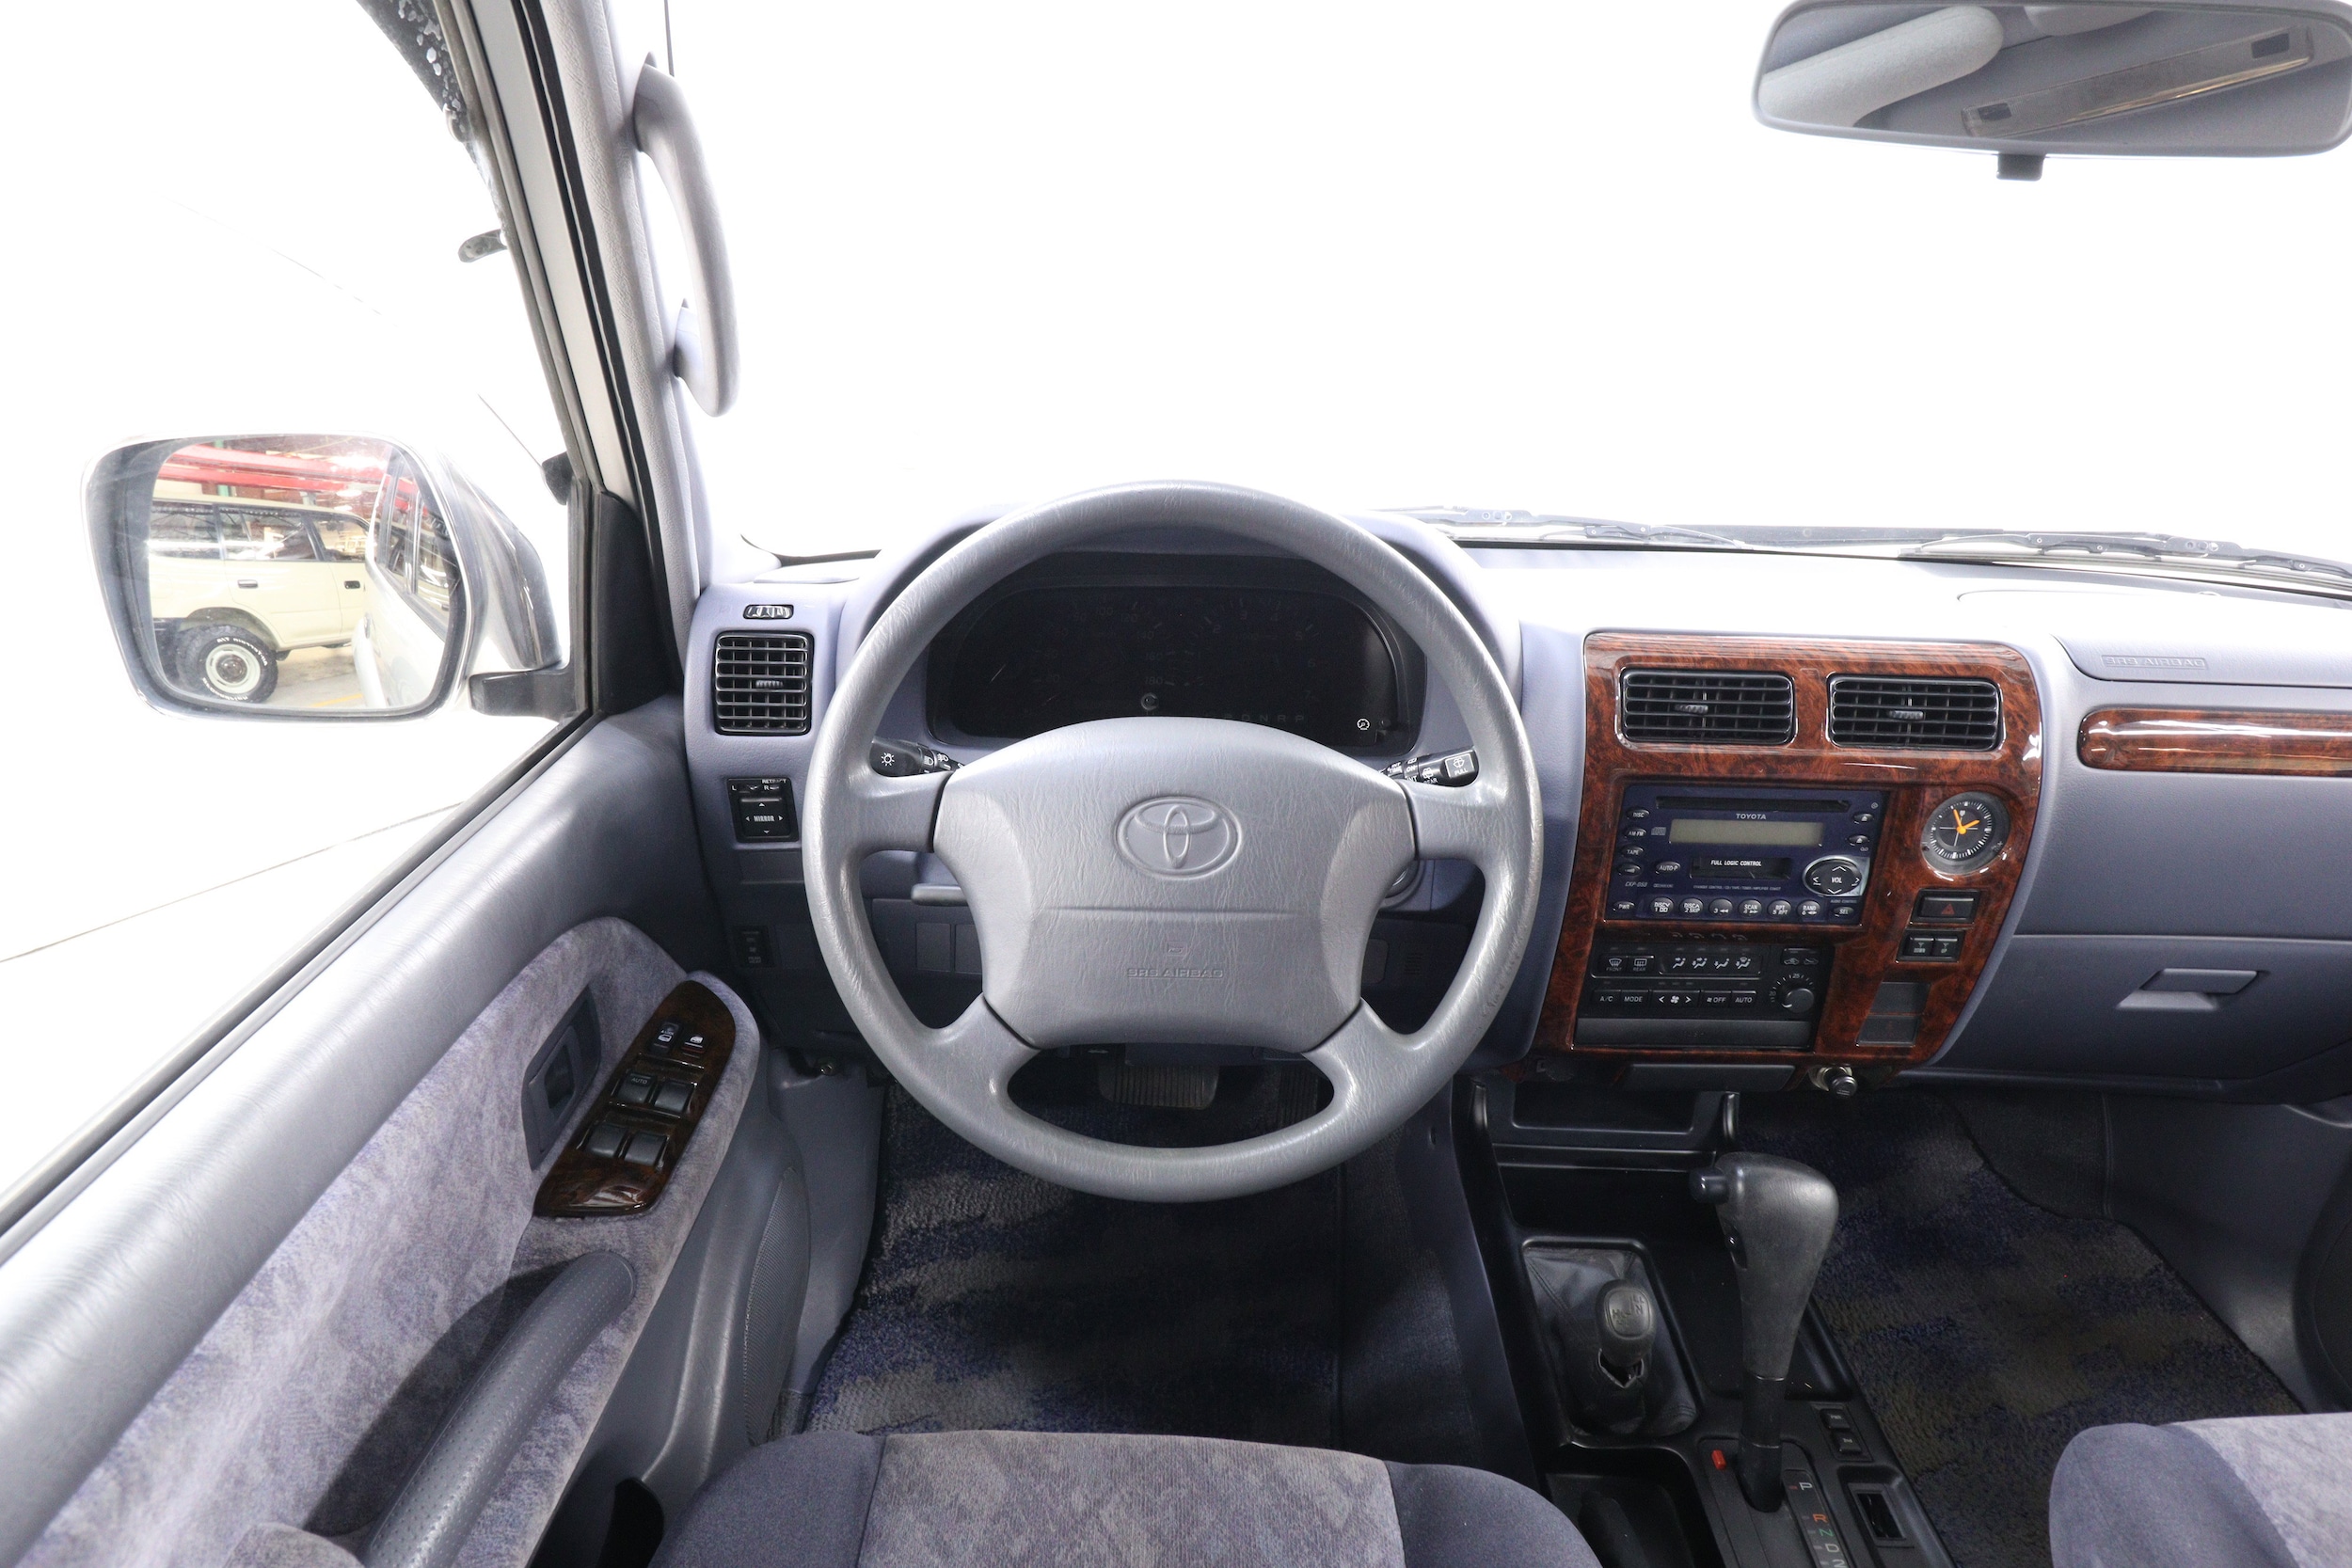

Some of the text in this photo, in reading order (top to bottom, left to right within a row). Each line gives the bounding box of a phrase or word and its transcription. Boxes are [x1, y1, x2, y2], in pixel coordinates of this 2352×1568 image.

[2106, 657, 2206, 667] SRS AIRBAG
[1127, 968, 1224, 978] SRS AIRBAG
[1799, 1481, 1813, 1491] P
[1813, 1513, 1829, 1523] R
[1819, 1528, 1834, 1537] N
[1825, 1544, 1840, 1552] D
[1832, 1560, 1847, 1568] 2
